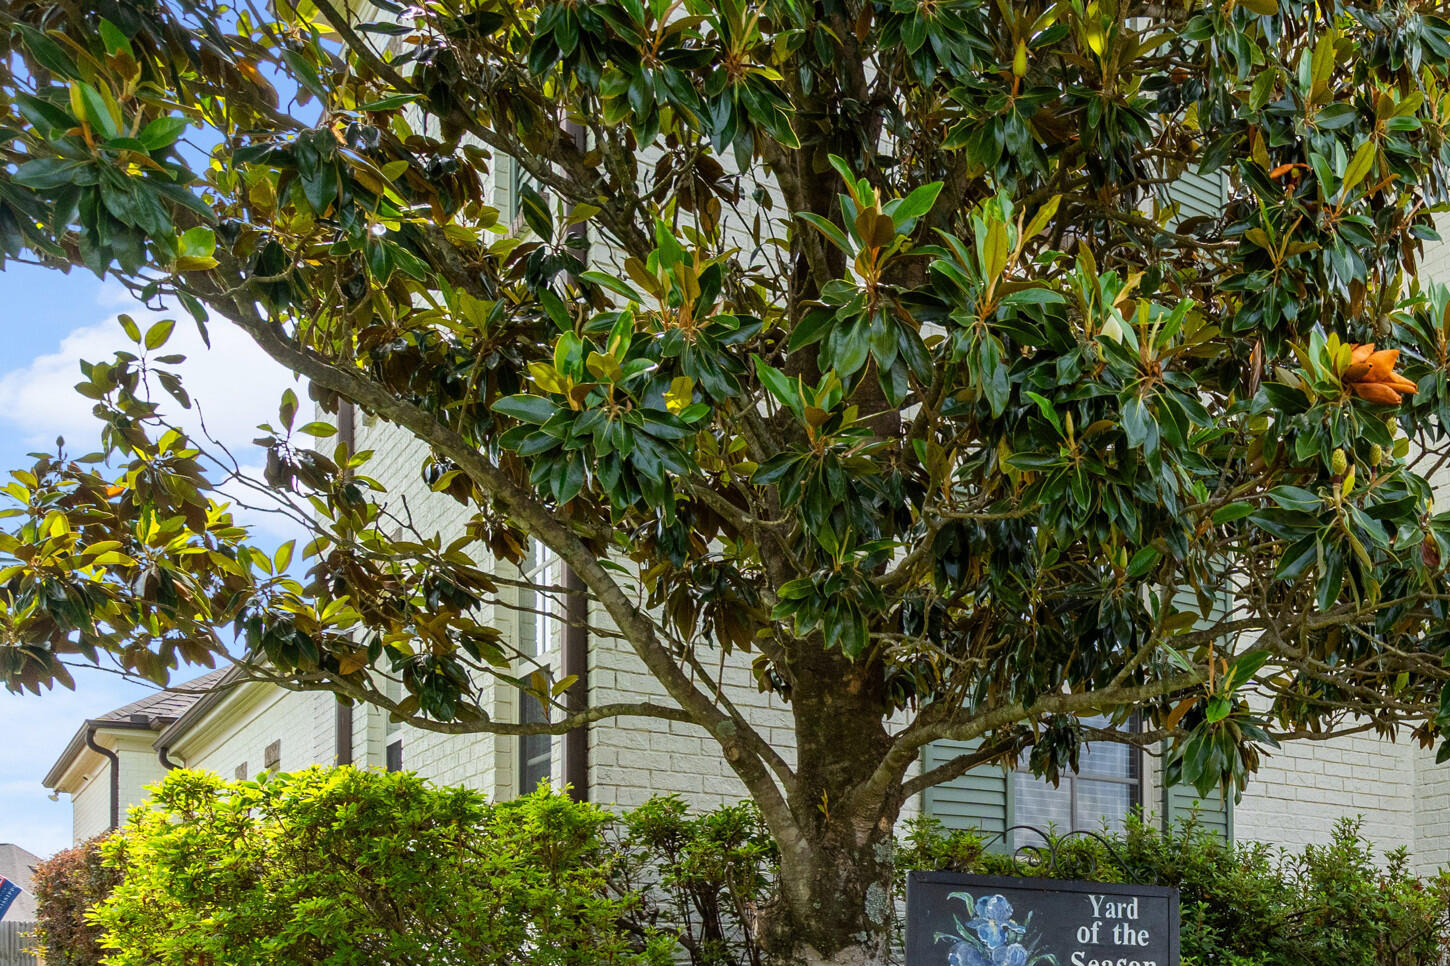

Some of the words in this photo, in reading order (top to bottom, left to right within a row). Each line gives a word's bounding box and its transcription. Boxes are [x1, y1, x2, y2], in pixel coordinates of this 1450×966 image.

[1088, 895, 1139, 920] Yard
[1077, 921, 1102, 944] of
[1113, 922, 1150, 947] the
